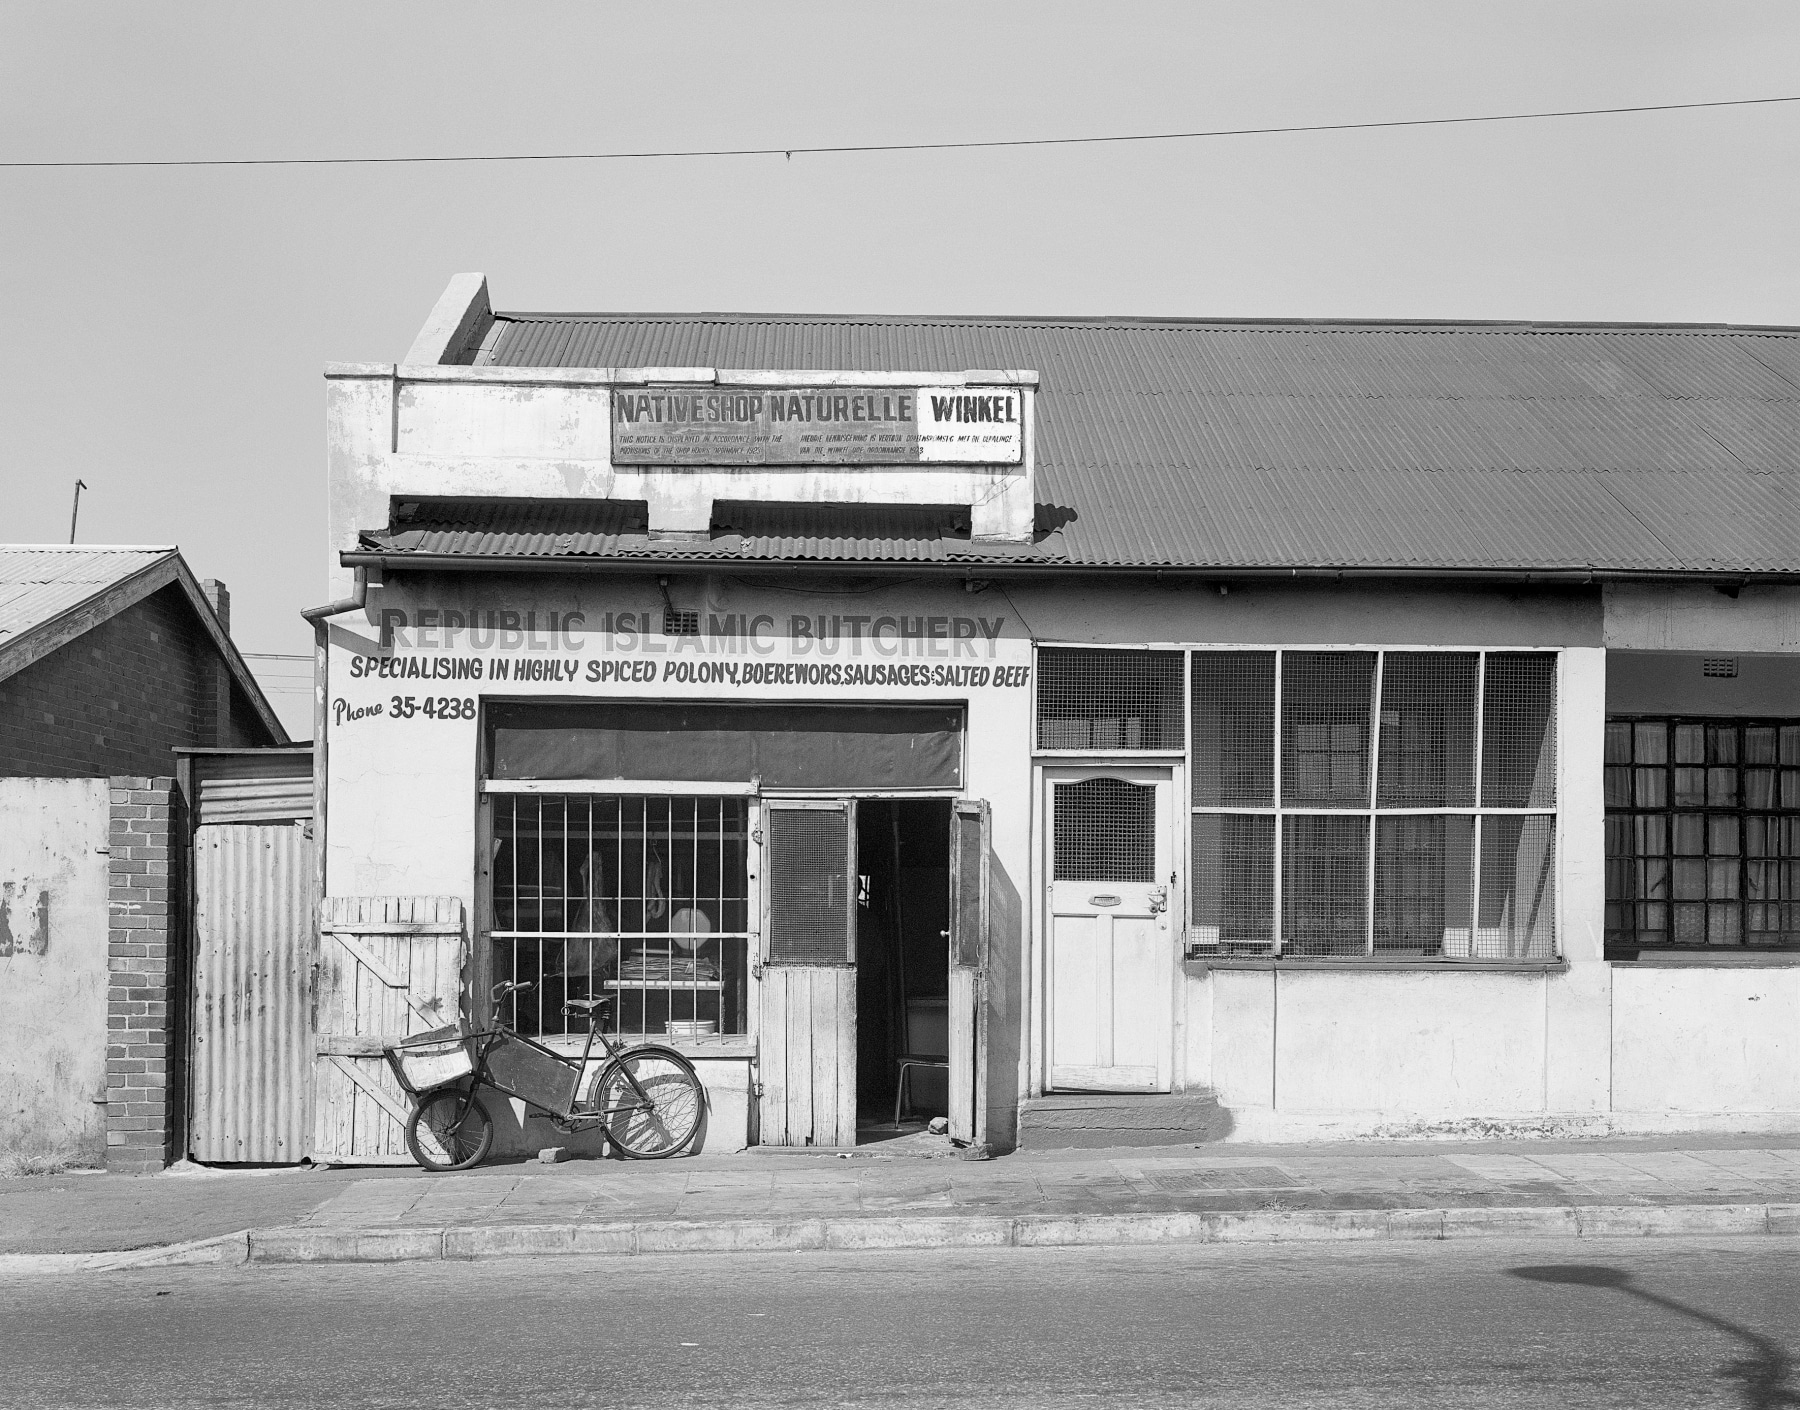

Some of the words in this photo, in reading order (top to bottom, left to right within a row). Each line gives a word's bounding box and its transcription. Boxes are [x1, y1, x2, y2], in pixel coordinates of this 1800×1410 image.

[617, 395, 704, 422] NATIVE
[707, 395, 763, 422] SHOP
[771, 395, 912, 422] NATURELLE
[931, 395, 1017, 423] WINKEL
[619, 435, 633, 444] THIS
[636, 435, 657, 444] NOTICE
[658, 435, 665, 444] IS
[667, 435, 700, 444] DISPLAYED
[702, 435, 711, 443] IN
[713, 435, 750, 443] ACCORDANCE
[771, 434, 783, 443] THE
[799, 446, 811, 455] VAN
[870, 434, 877, 443] IS
[379, 608, 586, 652] REPUBLIC
[605, 610, 775, 656] ISLAMIC
[790, 614, 1006, 659] BUTCHERY
[350, 655, 483, 680] SPECIALISING
[489, 657, 508, 681] IN
[514, 658, 579, 682] HIGHLY
[585, 659, 657, 683] SPICED
[992, 665, 1030, 688] BEEF
[332, 698, 384, 726] Phone
[388, 695, 477, 720] 35-4238
